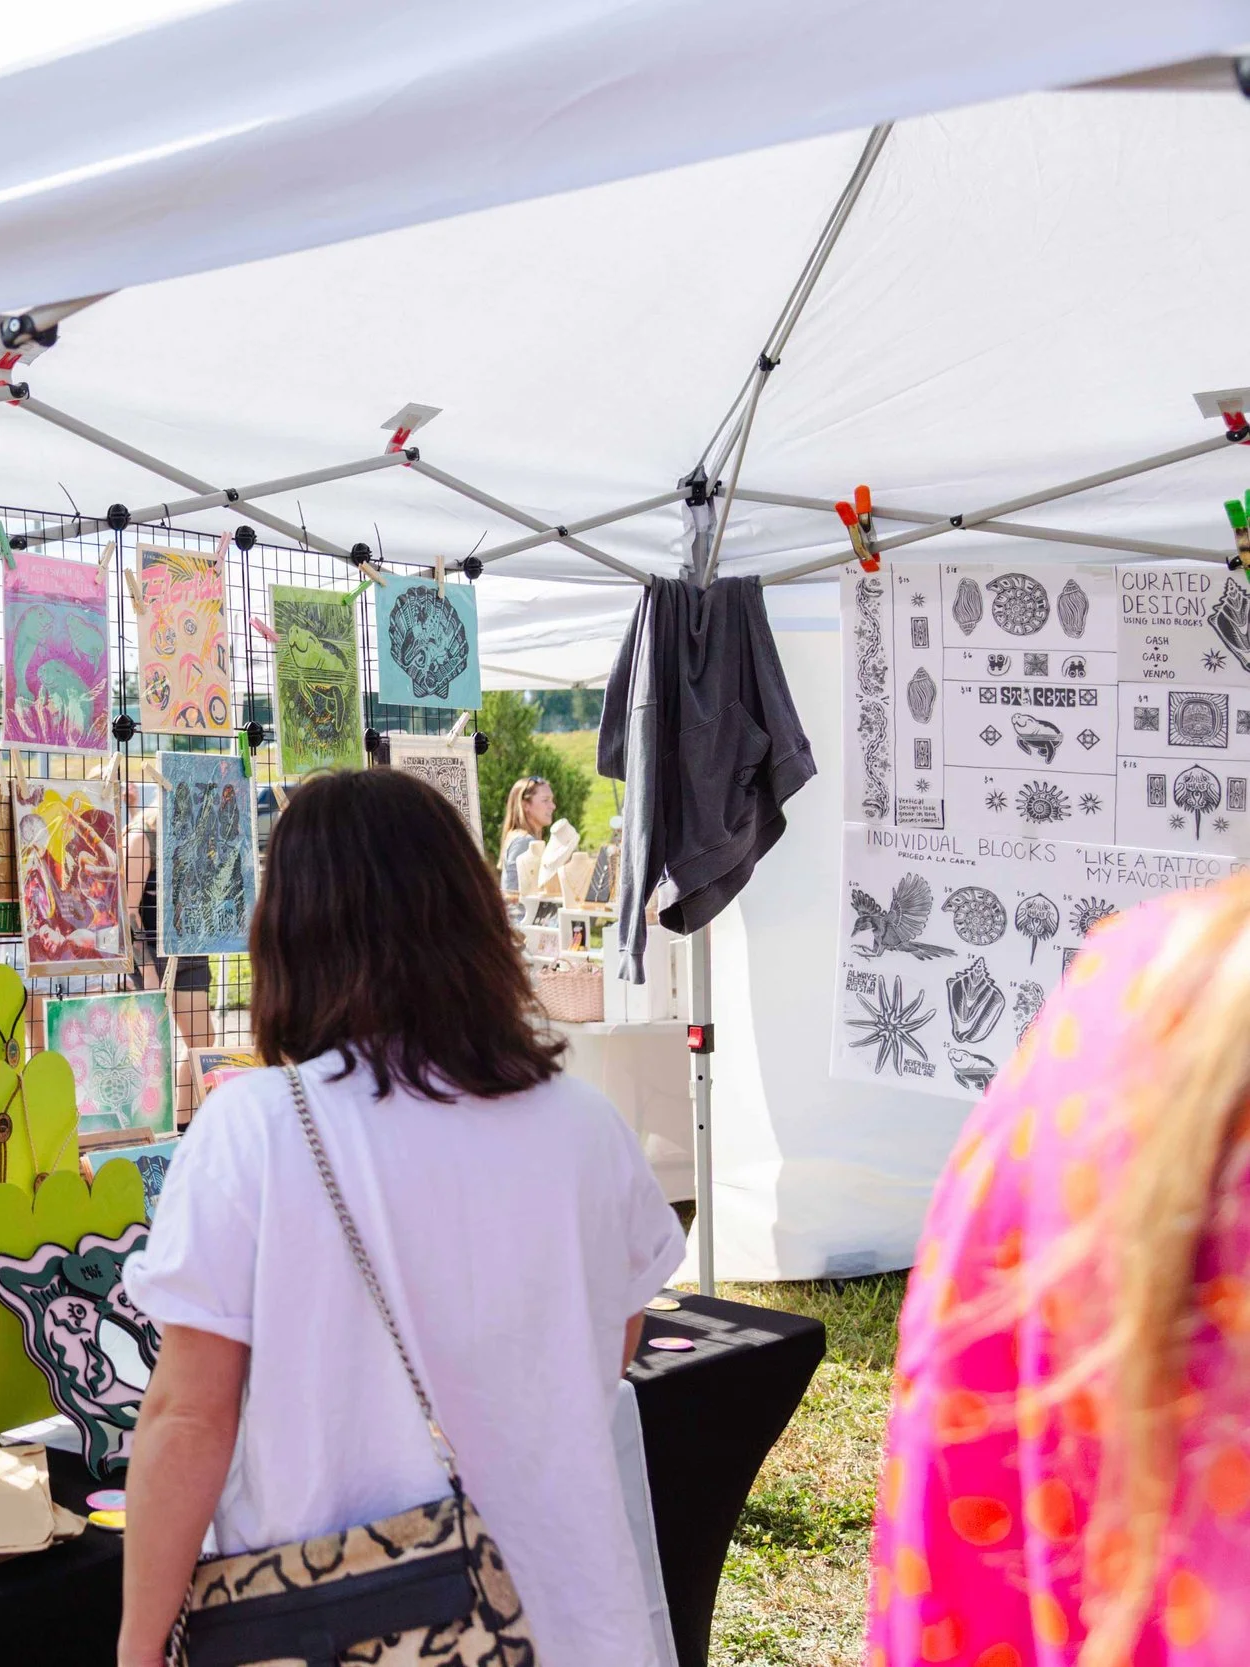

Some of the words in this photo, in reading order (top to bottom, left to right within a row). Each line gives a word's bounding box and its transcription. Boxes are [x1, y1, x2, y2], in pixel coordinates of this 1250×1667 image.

[1122, 572, 1210, 592] CURATED
[1122, 595, 1207, 617] DESIGNS
[1123, 616, 1148, 625] USING
[1174, 619, 1203, 627] BLOCKS
[1145, 636, 1169, 645] CASH
[1142, 652, 1168, 662] CARD
[1143, 670, 1175, 679] VENMO
[1033, 687, 1076, 707] PETE
[867, 830, 963, 855] INDIVIDUAL
[978, 838, 1056, 862] BLOCKS
[898, 851, 925, 861] PRICED
[950, 857, 977, 866] CARTE
[1134, 854, 1147, 869] A
[1153, 856, 1221, 875] TATTOO
[1087, 867, 1112, 884] MY
